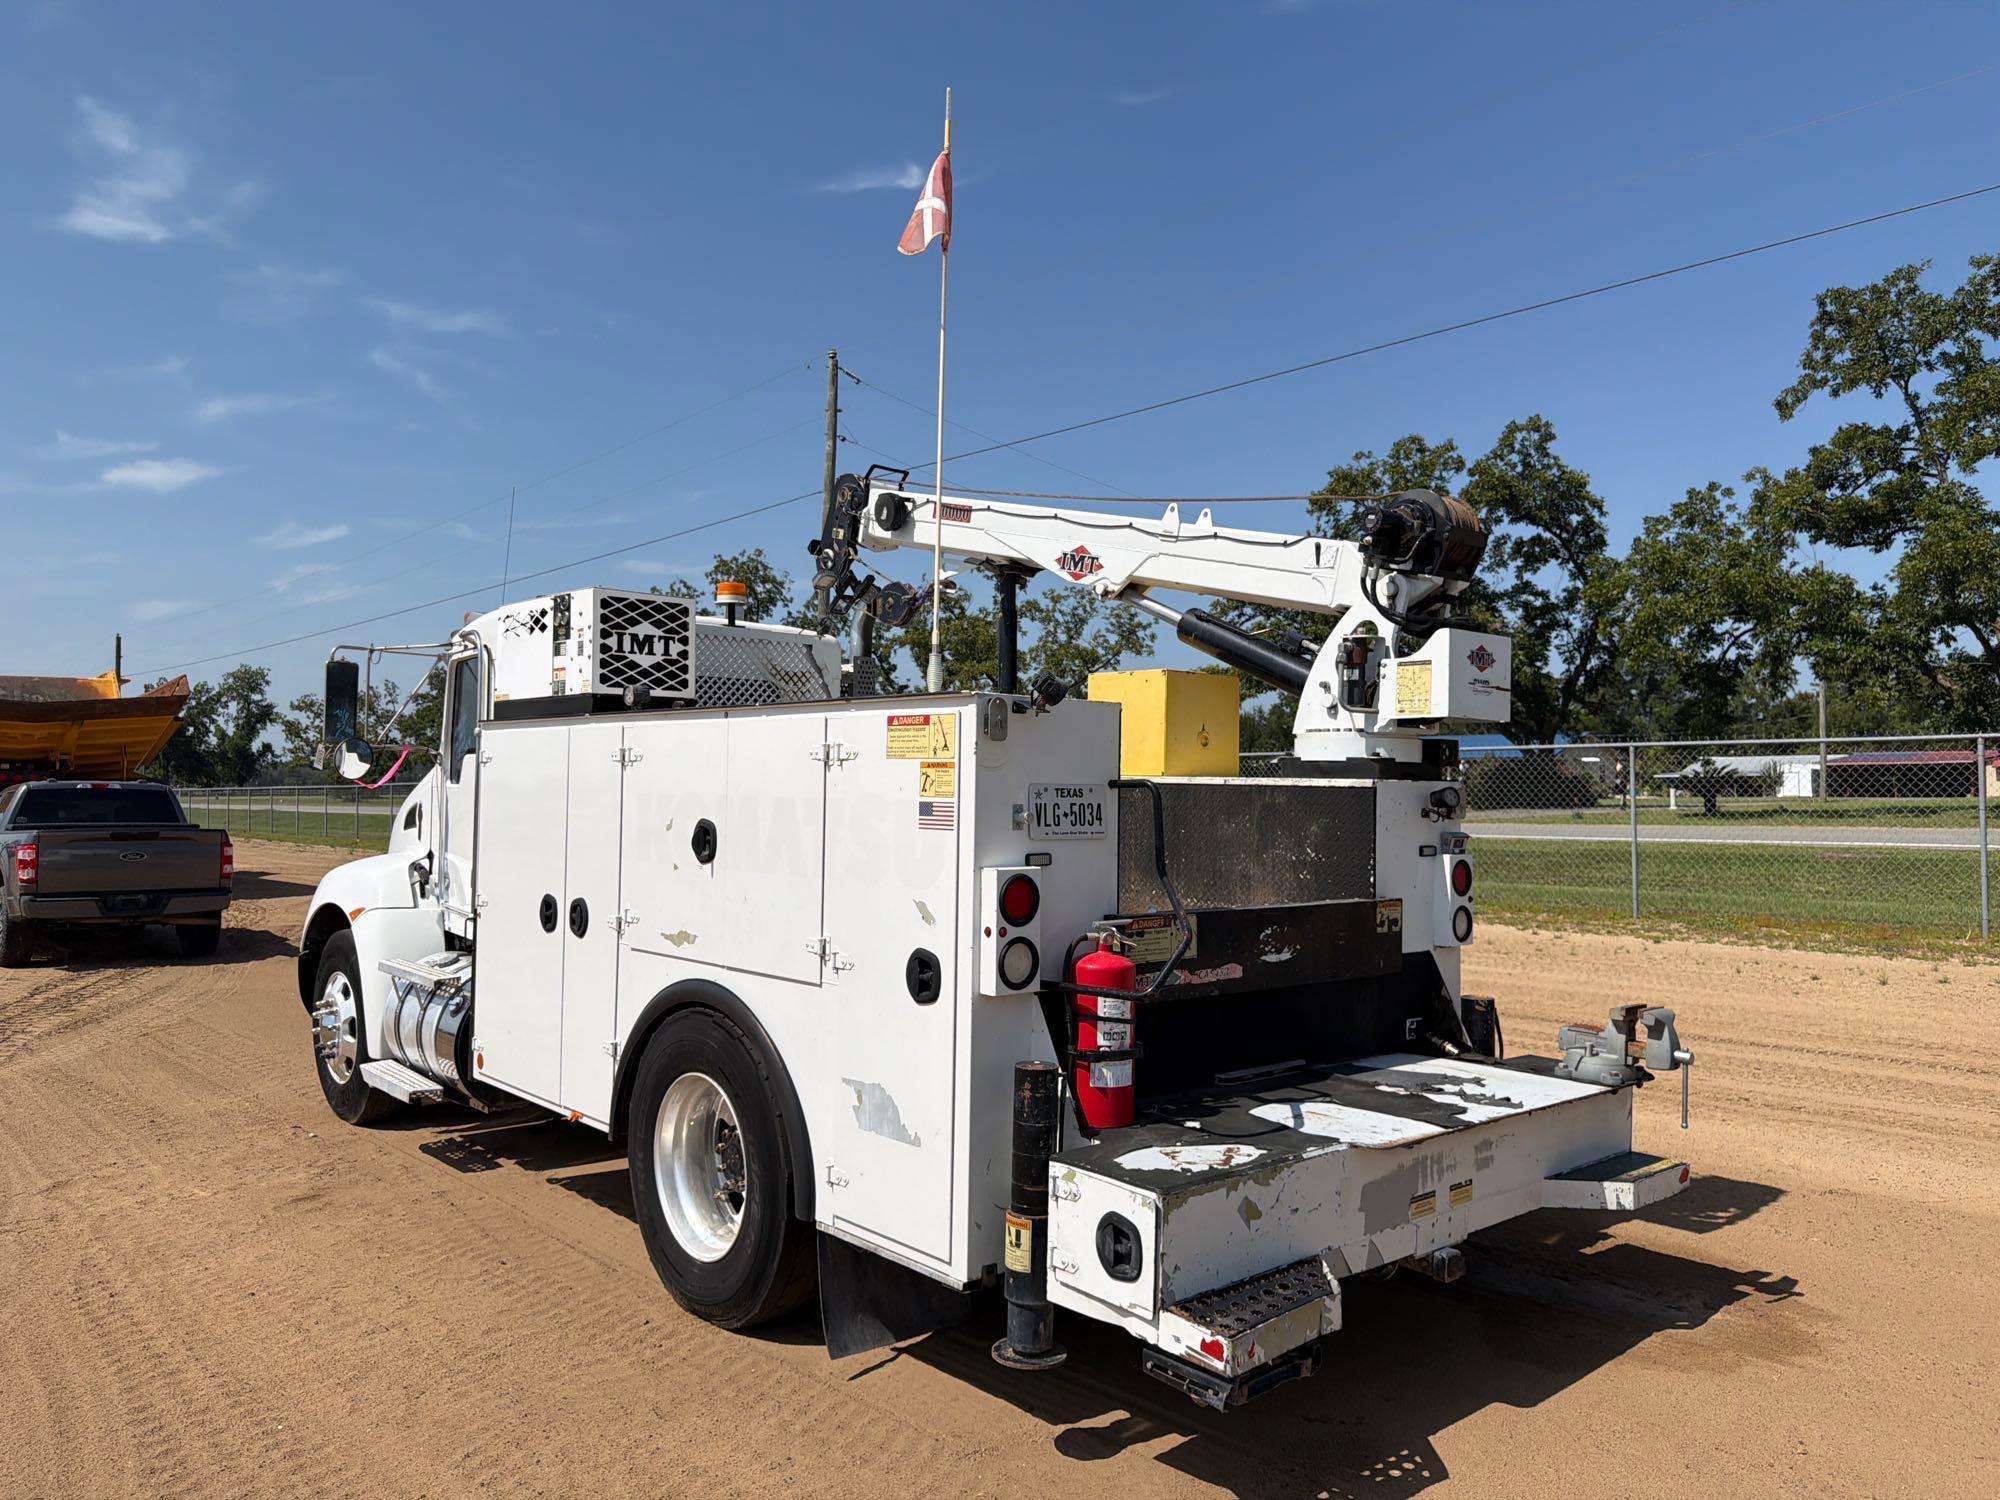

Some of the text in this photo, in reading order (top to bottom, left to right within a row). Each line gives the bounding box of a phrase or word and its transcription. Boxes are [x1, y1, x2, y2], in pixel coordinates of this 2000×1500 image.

[937, 504, 971, 522] 0000
[1060, 552, 1099, 574] IMT
[614, 631, 676, 657] IMT
[1470, 650, 1493, 667] IMT
[898, 716, 925, 725] DANGER
[1054, 788, 1084, 798] TEXAS
[1035, 803, 1103, 827] VLG 5034
